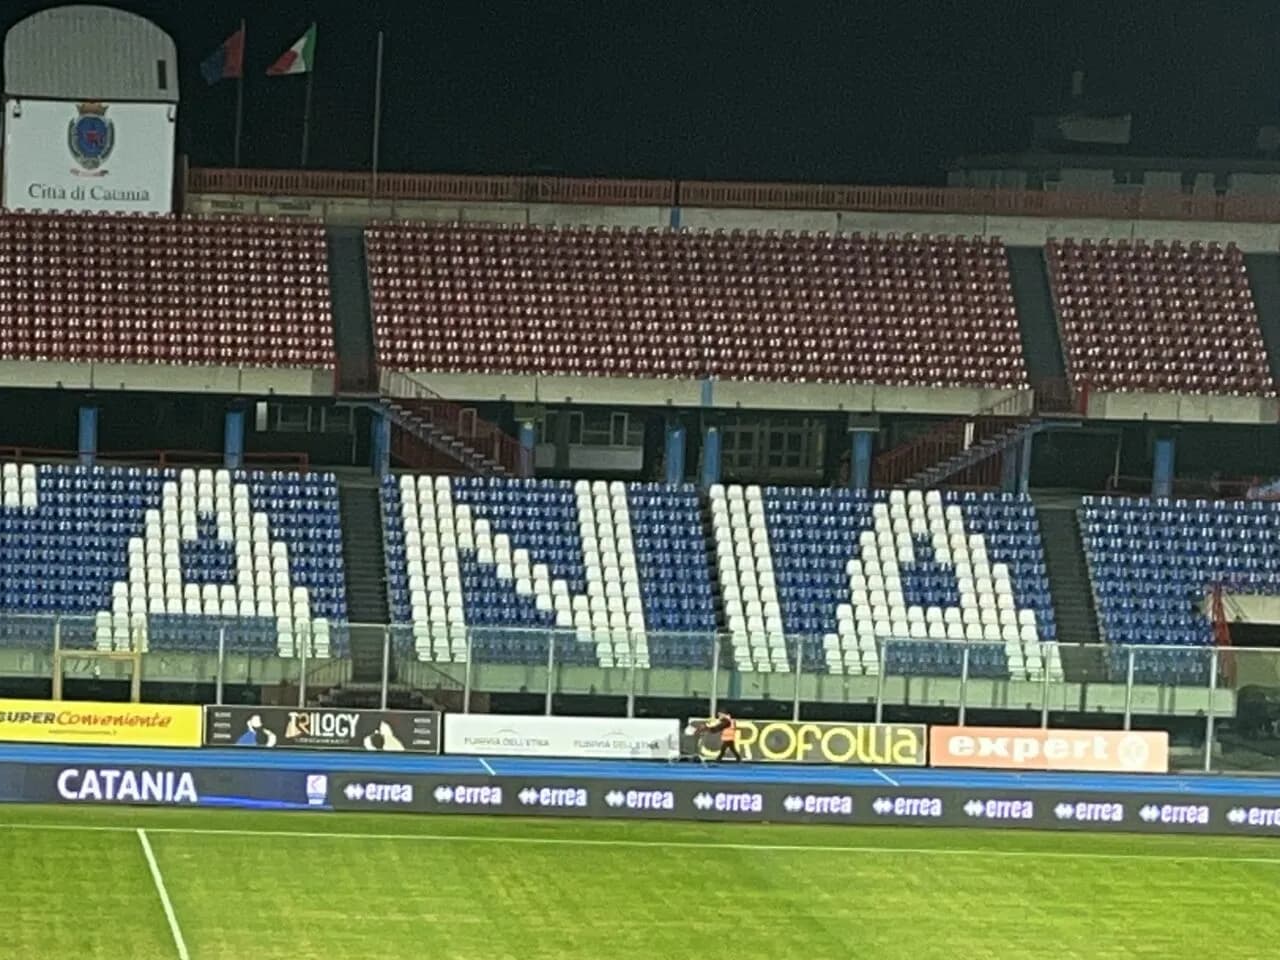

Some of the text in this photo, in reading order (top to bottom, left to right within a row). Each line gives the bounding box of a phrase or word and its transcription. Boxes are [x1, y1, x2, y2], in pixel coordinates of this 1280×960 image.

[70, 185, 85, 201] di
[947, 734, 1110, 763] expert
[57, 768, 197, 803] CATANIA
